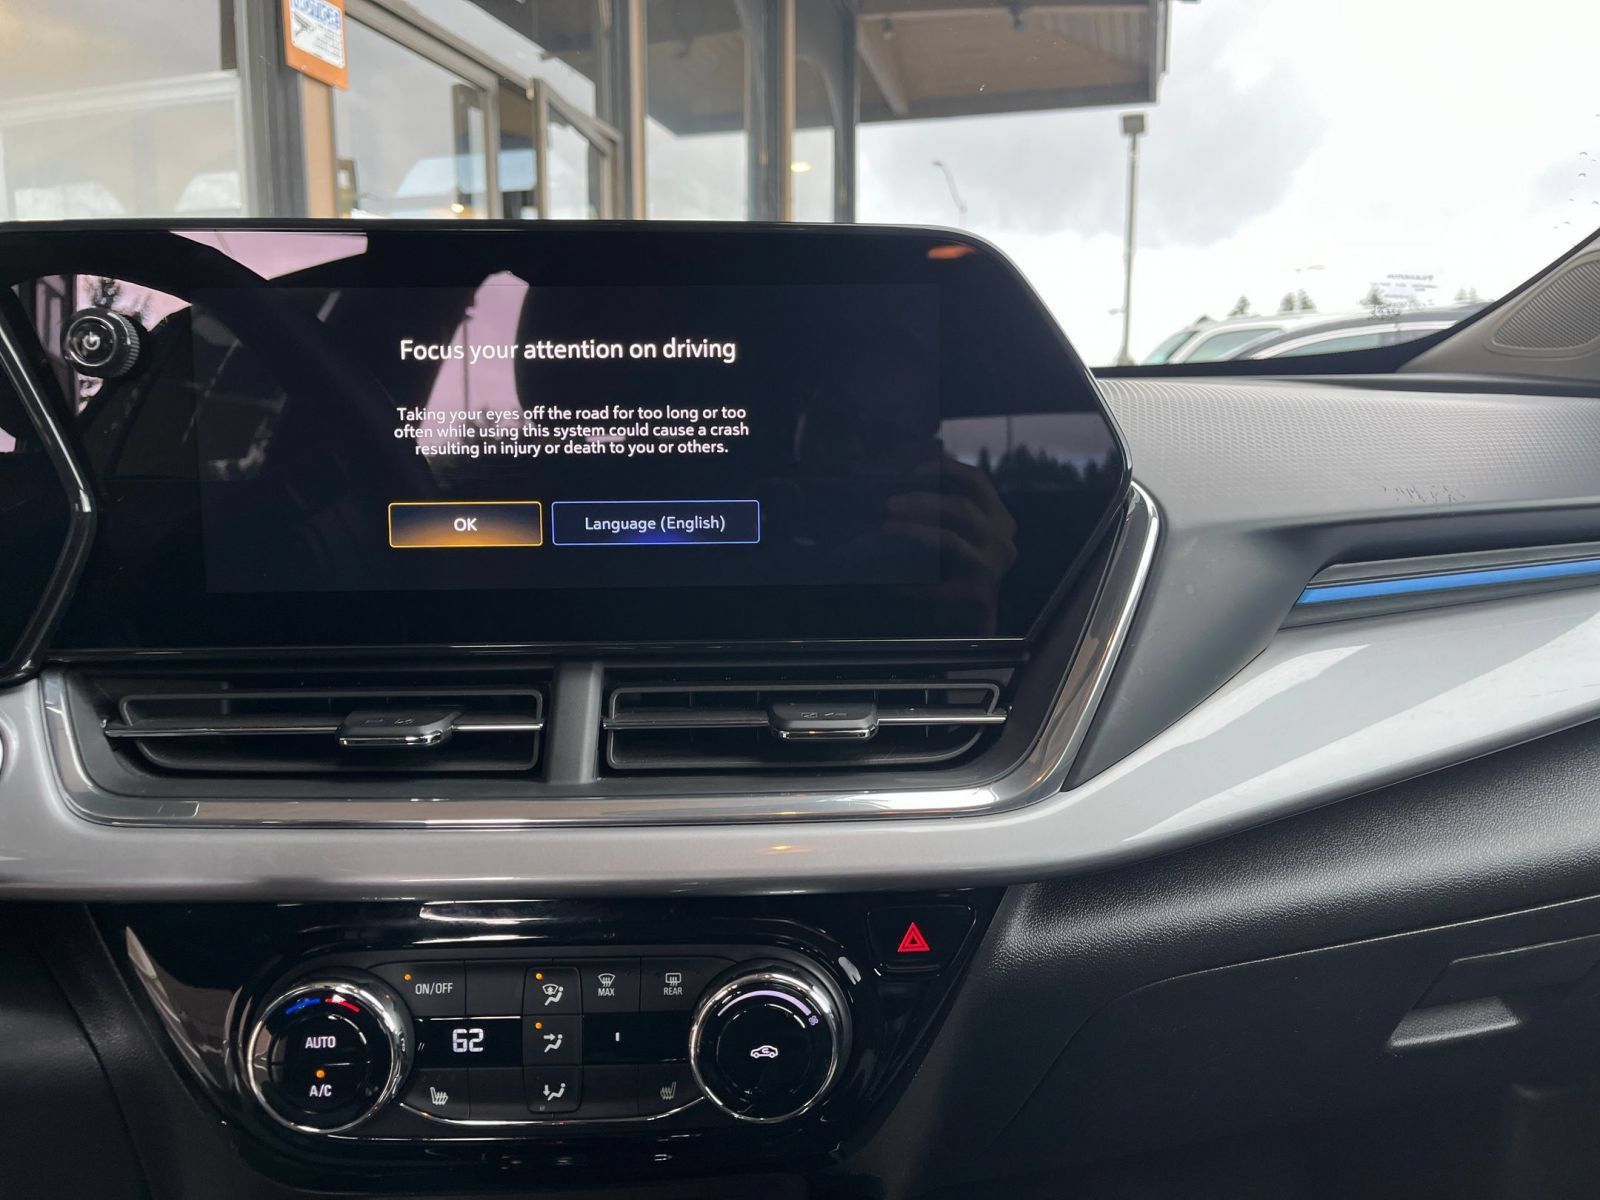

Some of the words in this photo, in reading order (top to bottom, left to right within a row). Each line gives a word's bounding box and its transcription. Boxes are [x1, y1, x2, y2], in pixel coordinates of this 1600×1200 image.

[400, 339, 465, 361] Focus
[469, 344, 519, 365] your
[523, 339, 624, 359] attention
[629, 343, 657, 359] on
[662, 337, 736, 364] driving
[396, 407, 446, 423] Taking
[450, 409, 482, 423] your
[486, 409, 520, 423] eyes
[523, 405, 545, 420] off
[548, 406, 572, 420] the
[576, 405, 609, 420] road
[613, 405, 634, 419] for
[637, 406, 663, 419] too
[666, 405, 699, 423] long
[702, 408, 718, 419] or
[721, 406, 747, 419] too
[393, 424, 433, 439] often
[436, 424, 475, 438] while
[479, 424, 519, 441] using
[522, 424, 550, 437] this
[553, 425, 605, 440] system
[609, 422, 649, 437] could
[652, 425, 695, 436] cause
[698, 425, 707, 436] a
[710, 421, 749, 436] crash
[415, 441, 480, 459] resulting
[483, 441, 497, 455] in
[500, 441, 541, 458] injury
[544, 443, 560, 454] or
[564, 440, 606, 454] death
[609, 441, 625, 454] to
[628, 442, 655, 457] you
[658, 442, 674, 453] or
[677, 439, 729, 453] others.
[453, 517, 478, 532] OK
[585, 516, 656, 534] Language
[660, 515, 726, 533] (English)
[415, 983, 453, 996] ON/OFF
[597, 987, 615, 997] MAX
[663, 986, 683, 996] REAR
[305, 1036, 337, 1049] AUTO
[452, 1028, 484, 1053] 62
[309, 1084, 332, 1097] A/C
